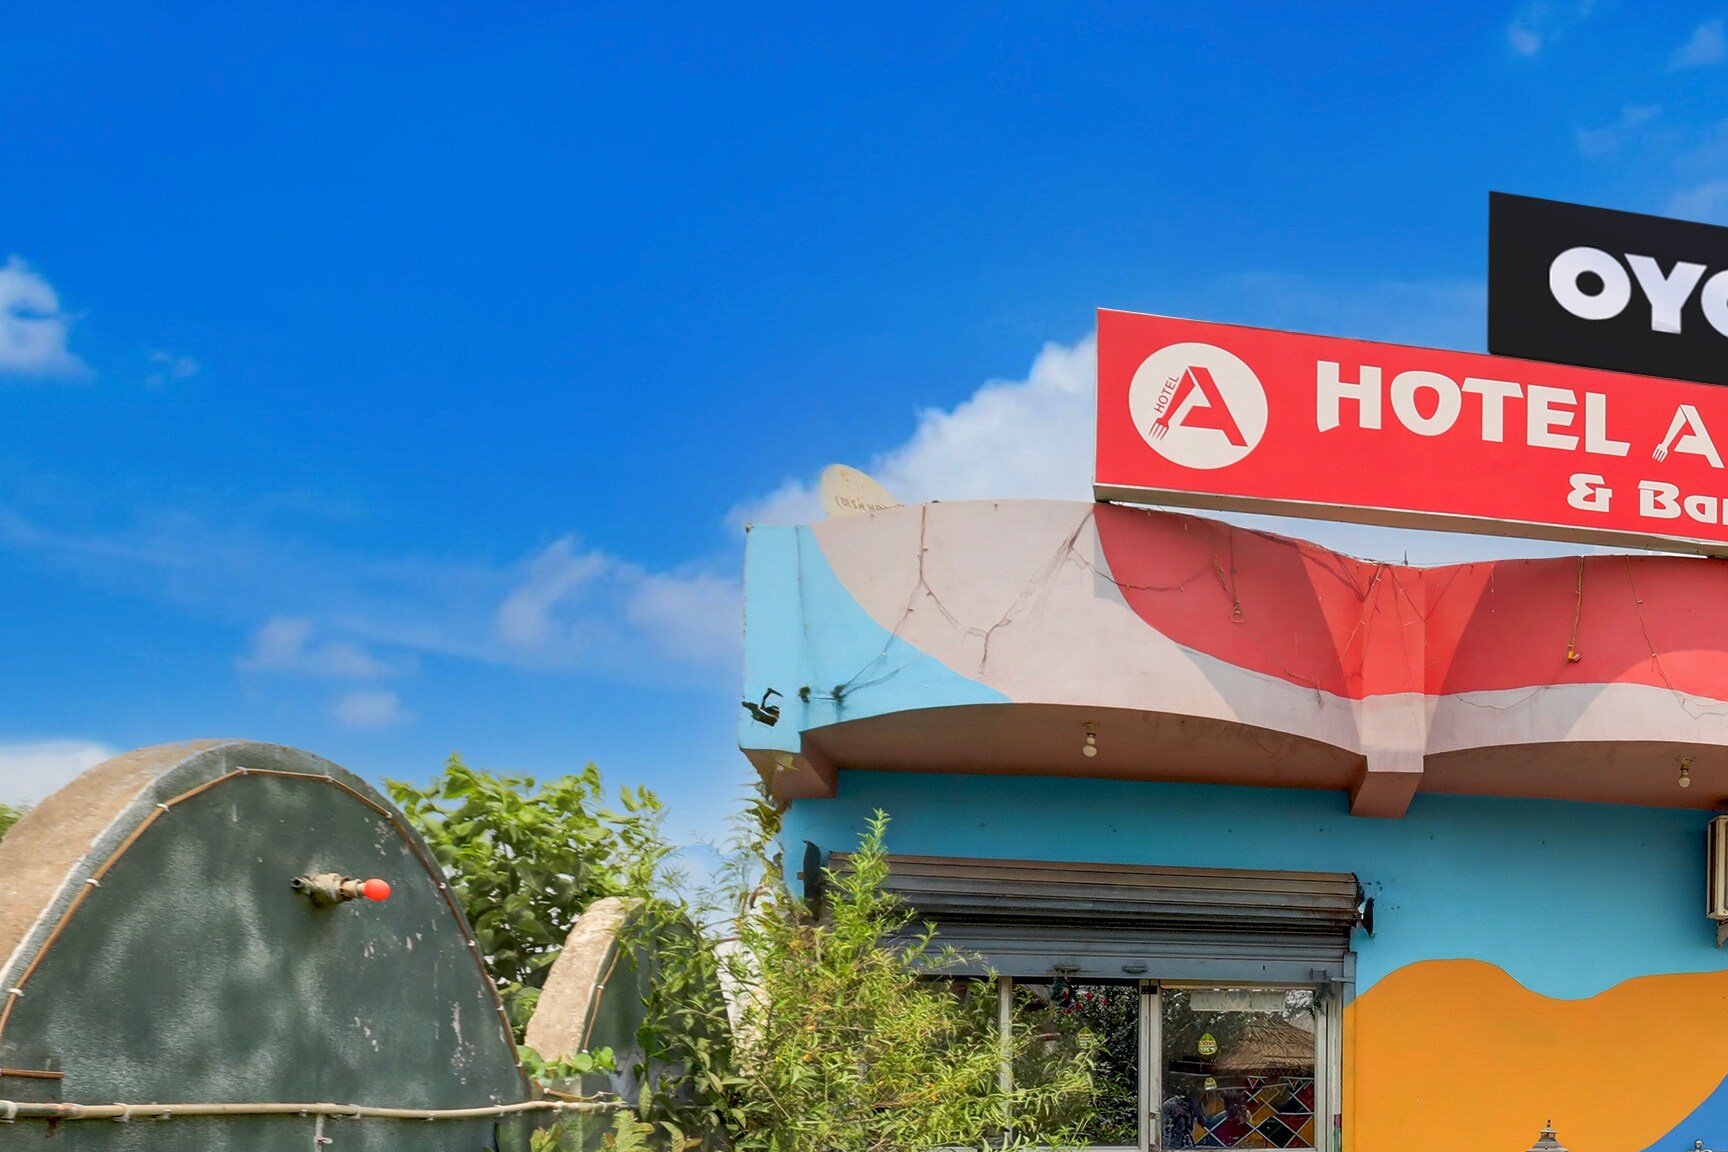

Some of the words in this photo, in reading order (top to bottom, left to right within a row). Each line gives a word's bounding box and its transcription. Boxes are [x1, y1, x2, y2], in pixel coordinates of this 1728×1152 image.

[1153, 376, 1180, 414] HOTEL
[1316, 360, 1631, 457] HOTEL
[1567, 473, 1613, 513] &
